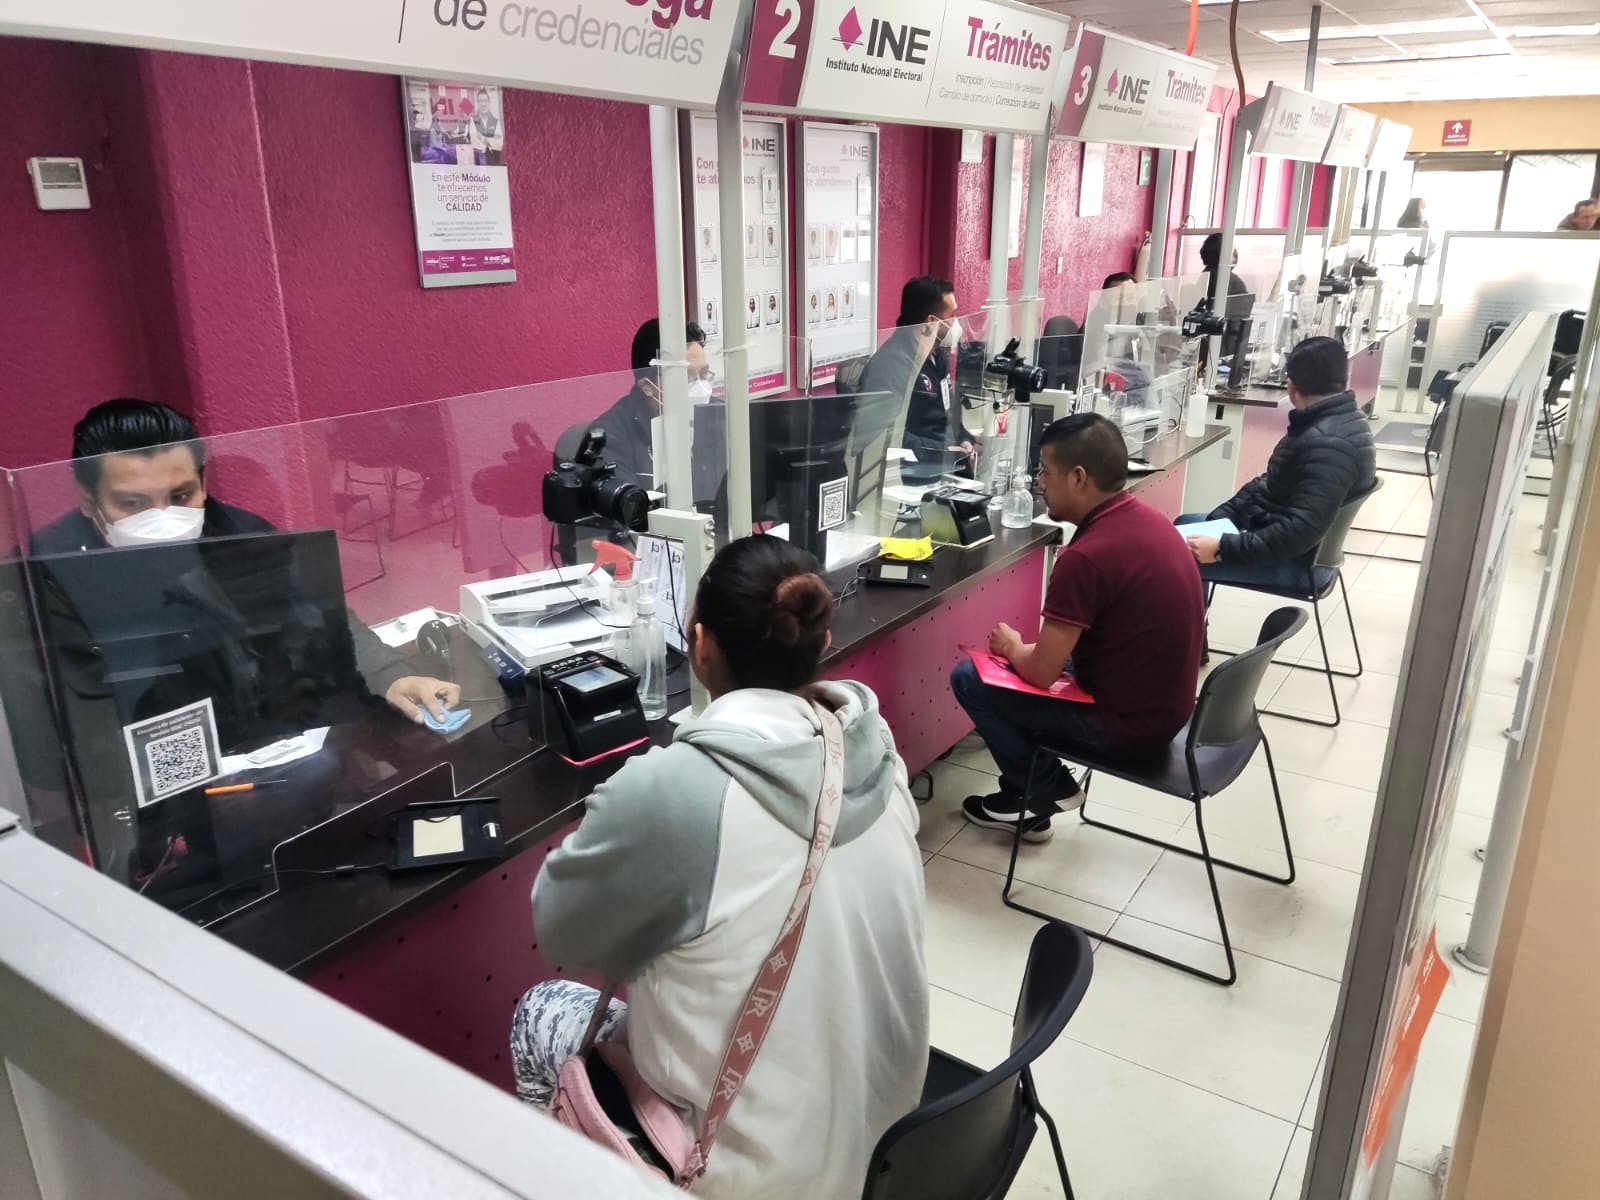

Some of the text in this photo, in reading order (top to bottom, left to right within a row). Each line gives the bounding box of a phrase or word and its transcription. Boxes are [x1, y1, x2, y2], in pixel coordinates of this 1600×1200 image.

[434, 0, 704, 65] de credenciales
[768, 0, 801, 59] 2
[867, 18, 931, 65] INE
[967, 16, 1052, 71] Trámites
[826, 57, 924, 82] Instituto Nacional Electoral
[1074, 65, 1092, 105] 3
[1118, 75, 1150, 104] INE
[1165, 70, 1206, 104] Trámites
[751, 138, 775, 151] INE
[849, 145, 868, 157] INE
[696, 157, 714, 169] Con
[461, 172, 491, 183] Módulo
[697, 174, 706, 184] te
[446, 202, 482, 212] CALIDAD
